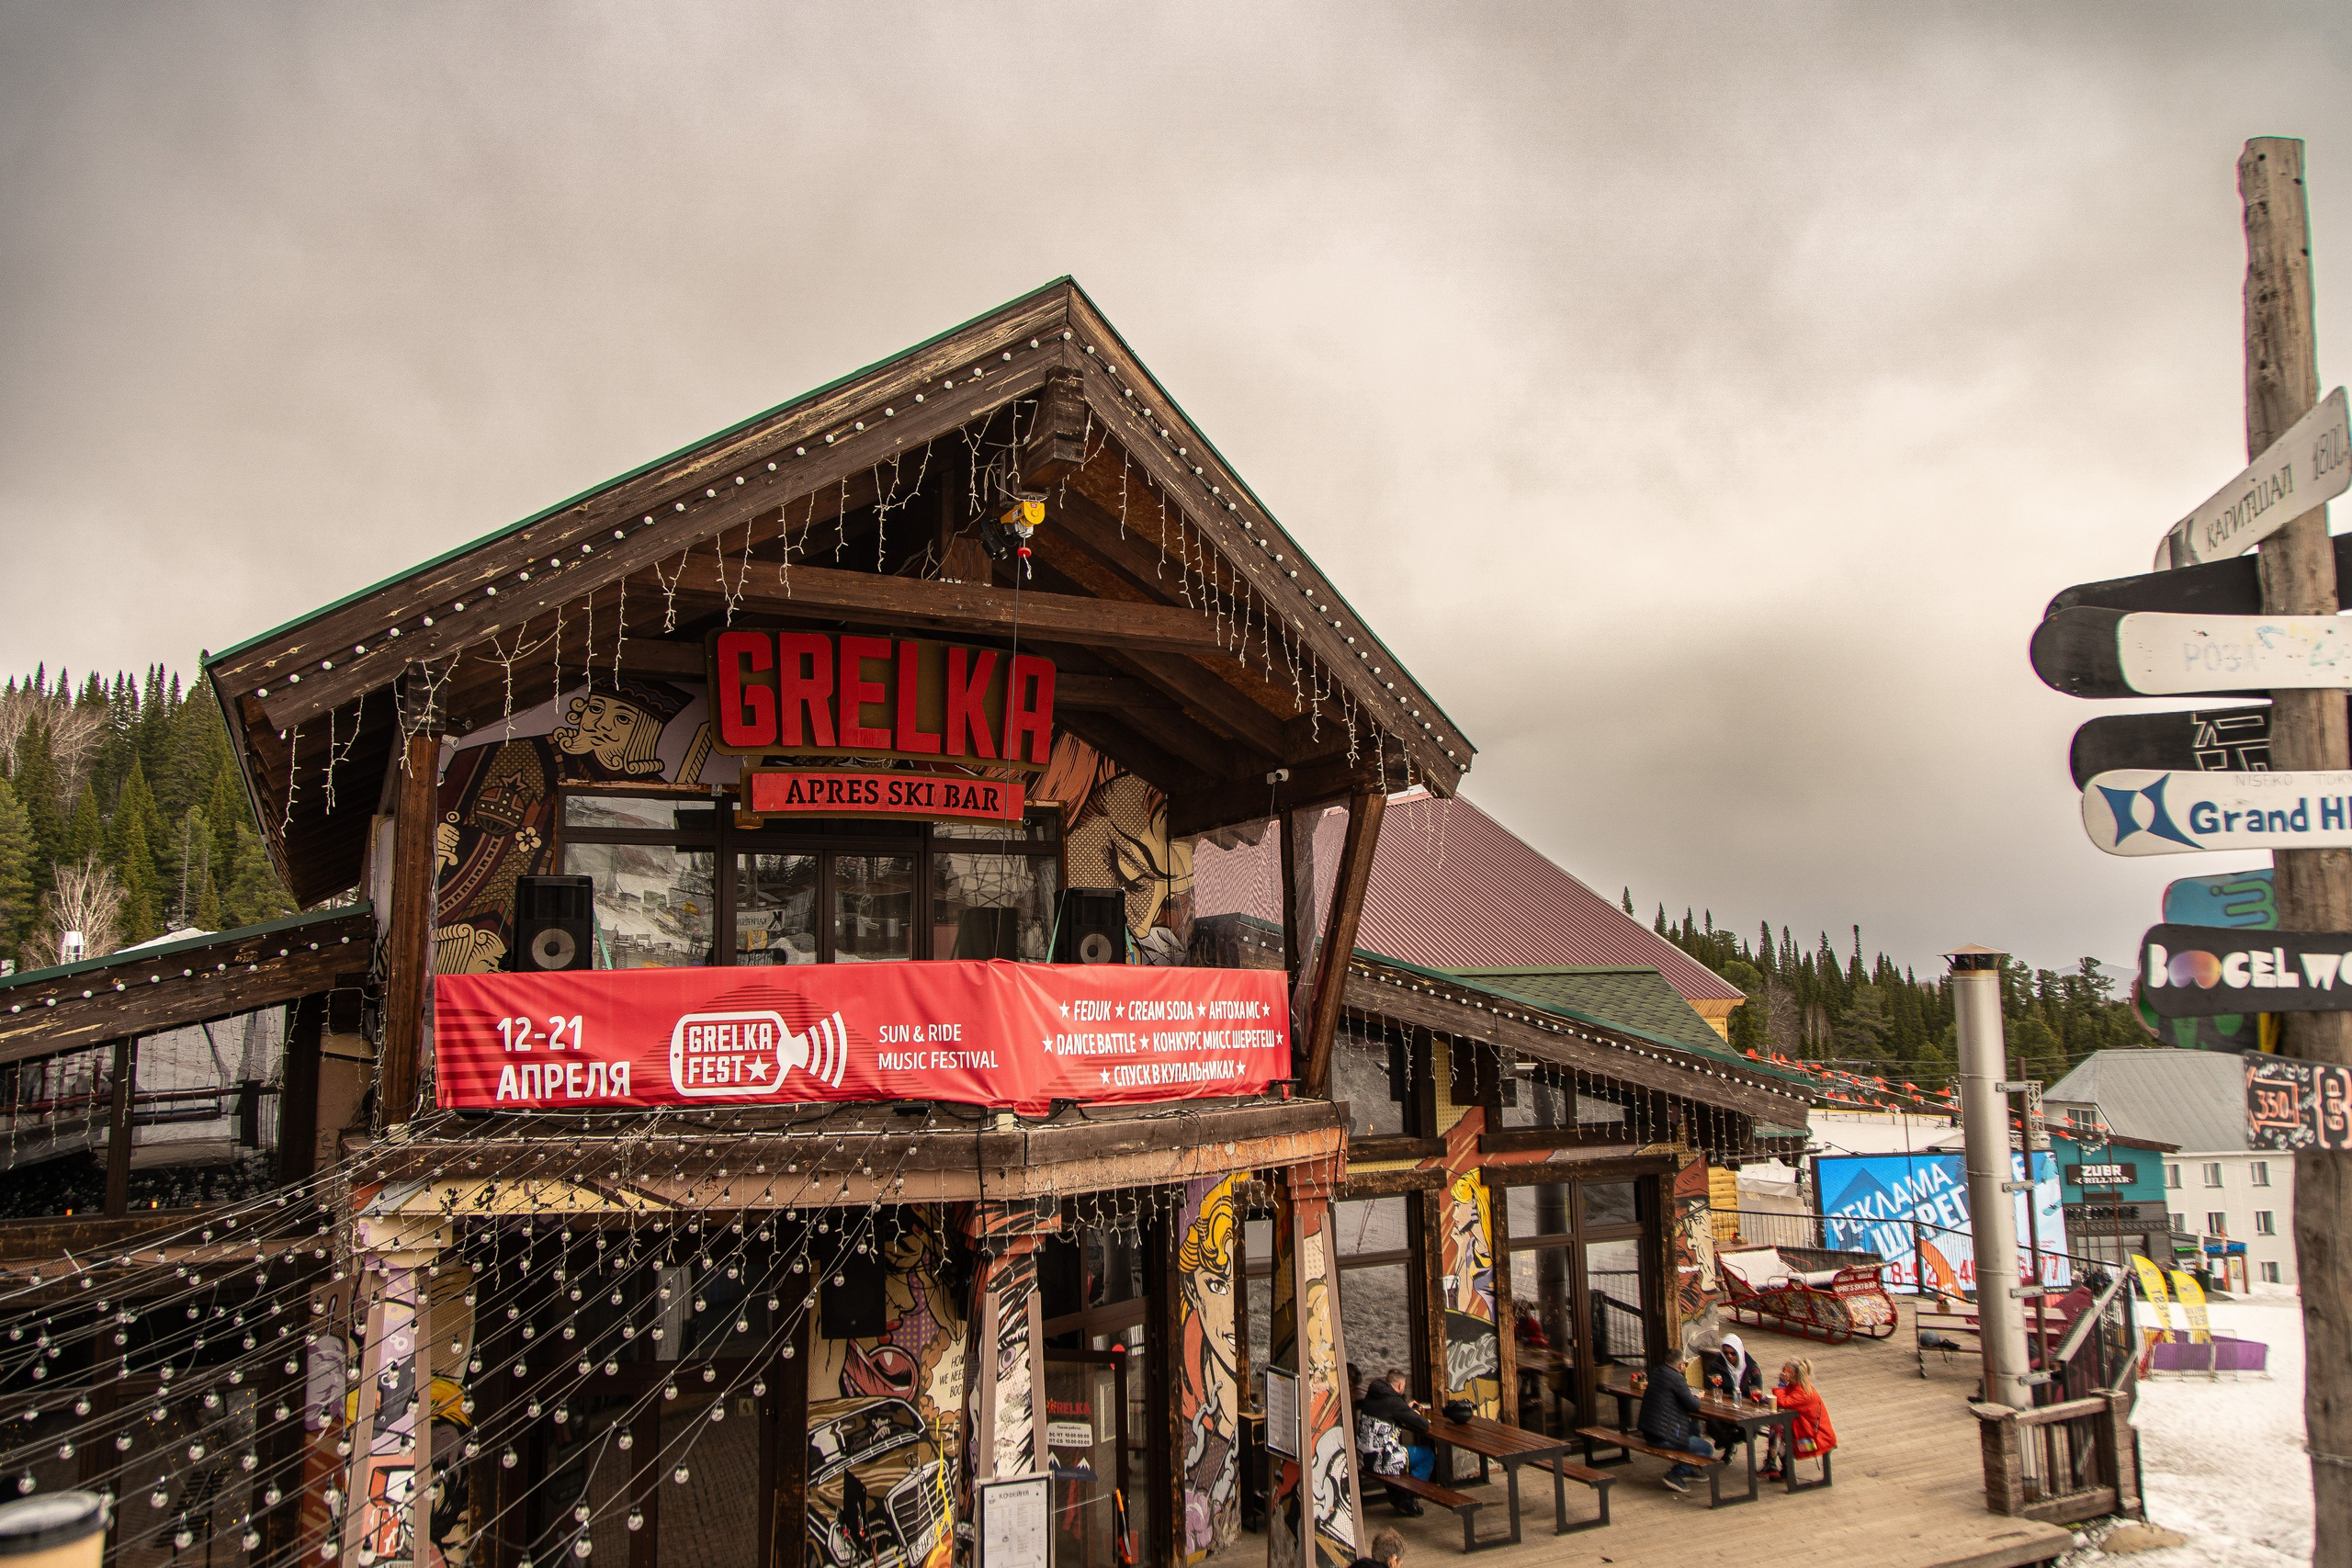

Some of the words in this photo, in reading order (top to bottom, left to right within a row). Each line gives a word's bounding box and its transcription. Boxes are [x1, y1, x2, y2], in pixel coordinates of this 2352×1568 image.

[717, 630, 1057, 764] GRELKA
[786, 778, 880, 805] APRES
[888, 781, 936, 807] SKI
[944, 784, 1000, 812] BAR
[2189, 796, 2312, 835] Grand
[2320, 796, 2352, 830] H
[1073, 1000, 1112, 1021] FEDUK
[1128, 1000, 1165, 1021] CREAM
[1167, 1000, 1194, 1021] SODA
[496, 1015, 583, 1052] 12-21
[688, 1022, 773, 1052] GRELKA
[878, 1025, 910, 1043] SUN
[912, 1025, 925, 1043] &
[928, 1023, 963, 1043] RIDE
[1057, 1033, 1096, 1055] DANCE
[1098, 1032, 1136, 1055] BATTLE
[1153, 1031, 1202, 1052] КОНКУРС
[1203, 1030, 1231, 1051] МИСС
[1232, 1029, 1275, 1049] ШЕРЕГЕШ
[687, 1055, 745, 1084] FEST
[878, 1051, 928, 1070] MUSIC
[931, 1050, 999, 1070] FESTIVAL
[1114, 1064, 1152, 1087] СПУСК
[1152, 1064, 1160, 1085] В
[1161, 1059, 1236, 1084] КУПАЛЬНИКАХ
[496, 1061, 631, 1100] АПРЕЛЯ
[2080, 1164, 2122, 1177] ZUBR
[1830, 1162, 1954, 1242] РЕКЛАМА
[1864, 1280, 1878, 1290] BAR
[939, 1372, 950, 1386] WE
[1048, 1401, 1091, 1415] GRELKA
